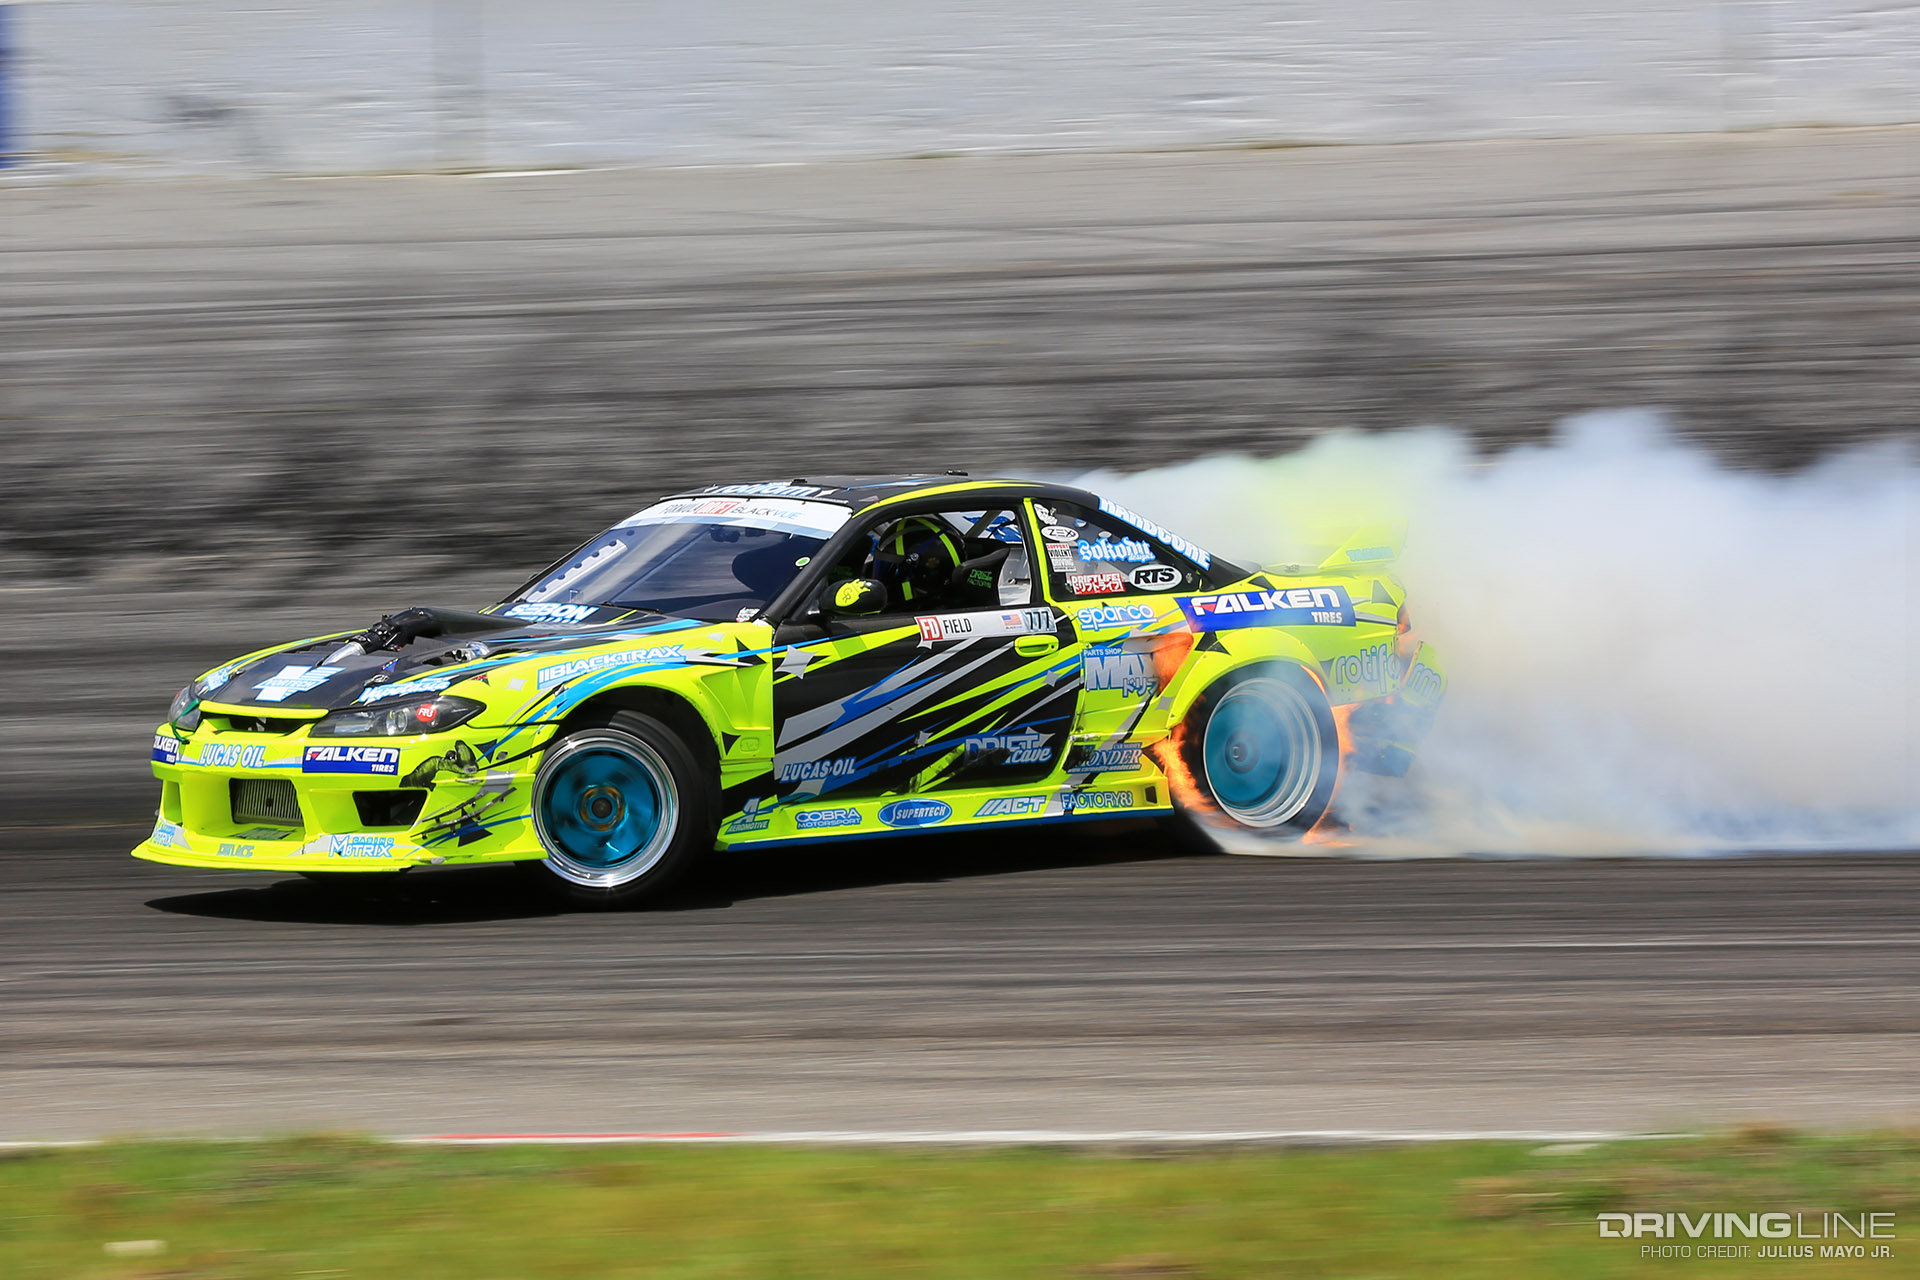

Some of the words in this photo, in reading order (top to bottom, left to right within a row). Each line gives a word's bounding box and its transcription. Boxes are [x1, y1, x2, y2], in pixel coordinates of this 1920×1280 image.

[1134, 568, 1175, 585] RTS
[1190, 588, 1341, 615] FALKEN
[504, 603, 600, 621] SEBON
[1025, 611, 1050, 630] 777
[1078, 604, 1154, 630] sparco
[1311, 611, 1343, 624] TIRES
[921, 617, 941, 639] FD
[943, 618, 973, 634] FIELD
[199, 744, 242, 767] LUCAS
[241, 745, 266, 768] OIL
[305, 747, 399, 763] FALKEN
[1082, 750, 1143, 767] ONDER
[371, 764, 395, 773] TIRES
[781, 759, 831, 782] LUCAS
[831, 757, 856, 775] OIL
[796, 809, 860, 822] COBRA
[797, 818, 861, 829] MOTORSPORT
[727, 820, 768, 833] AEROMOTIVE
